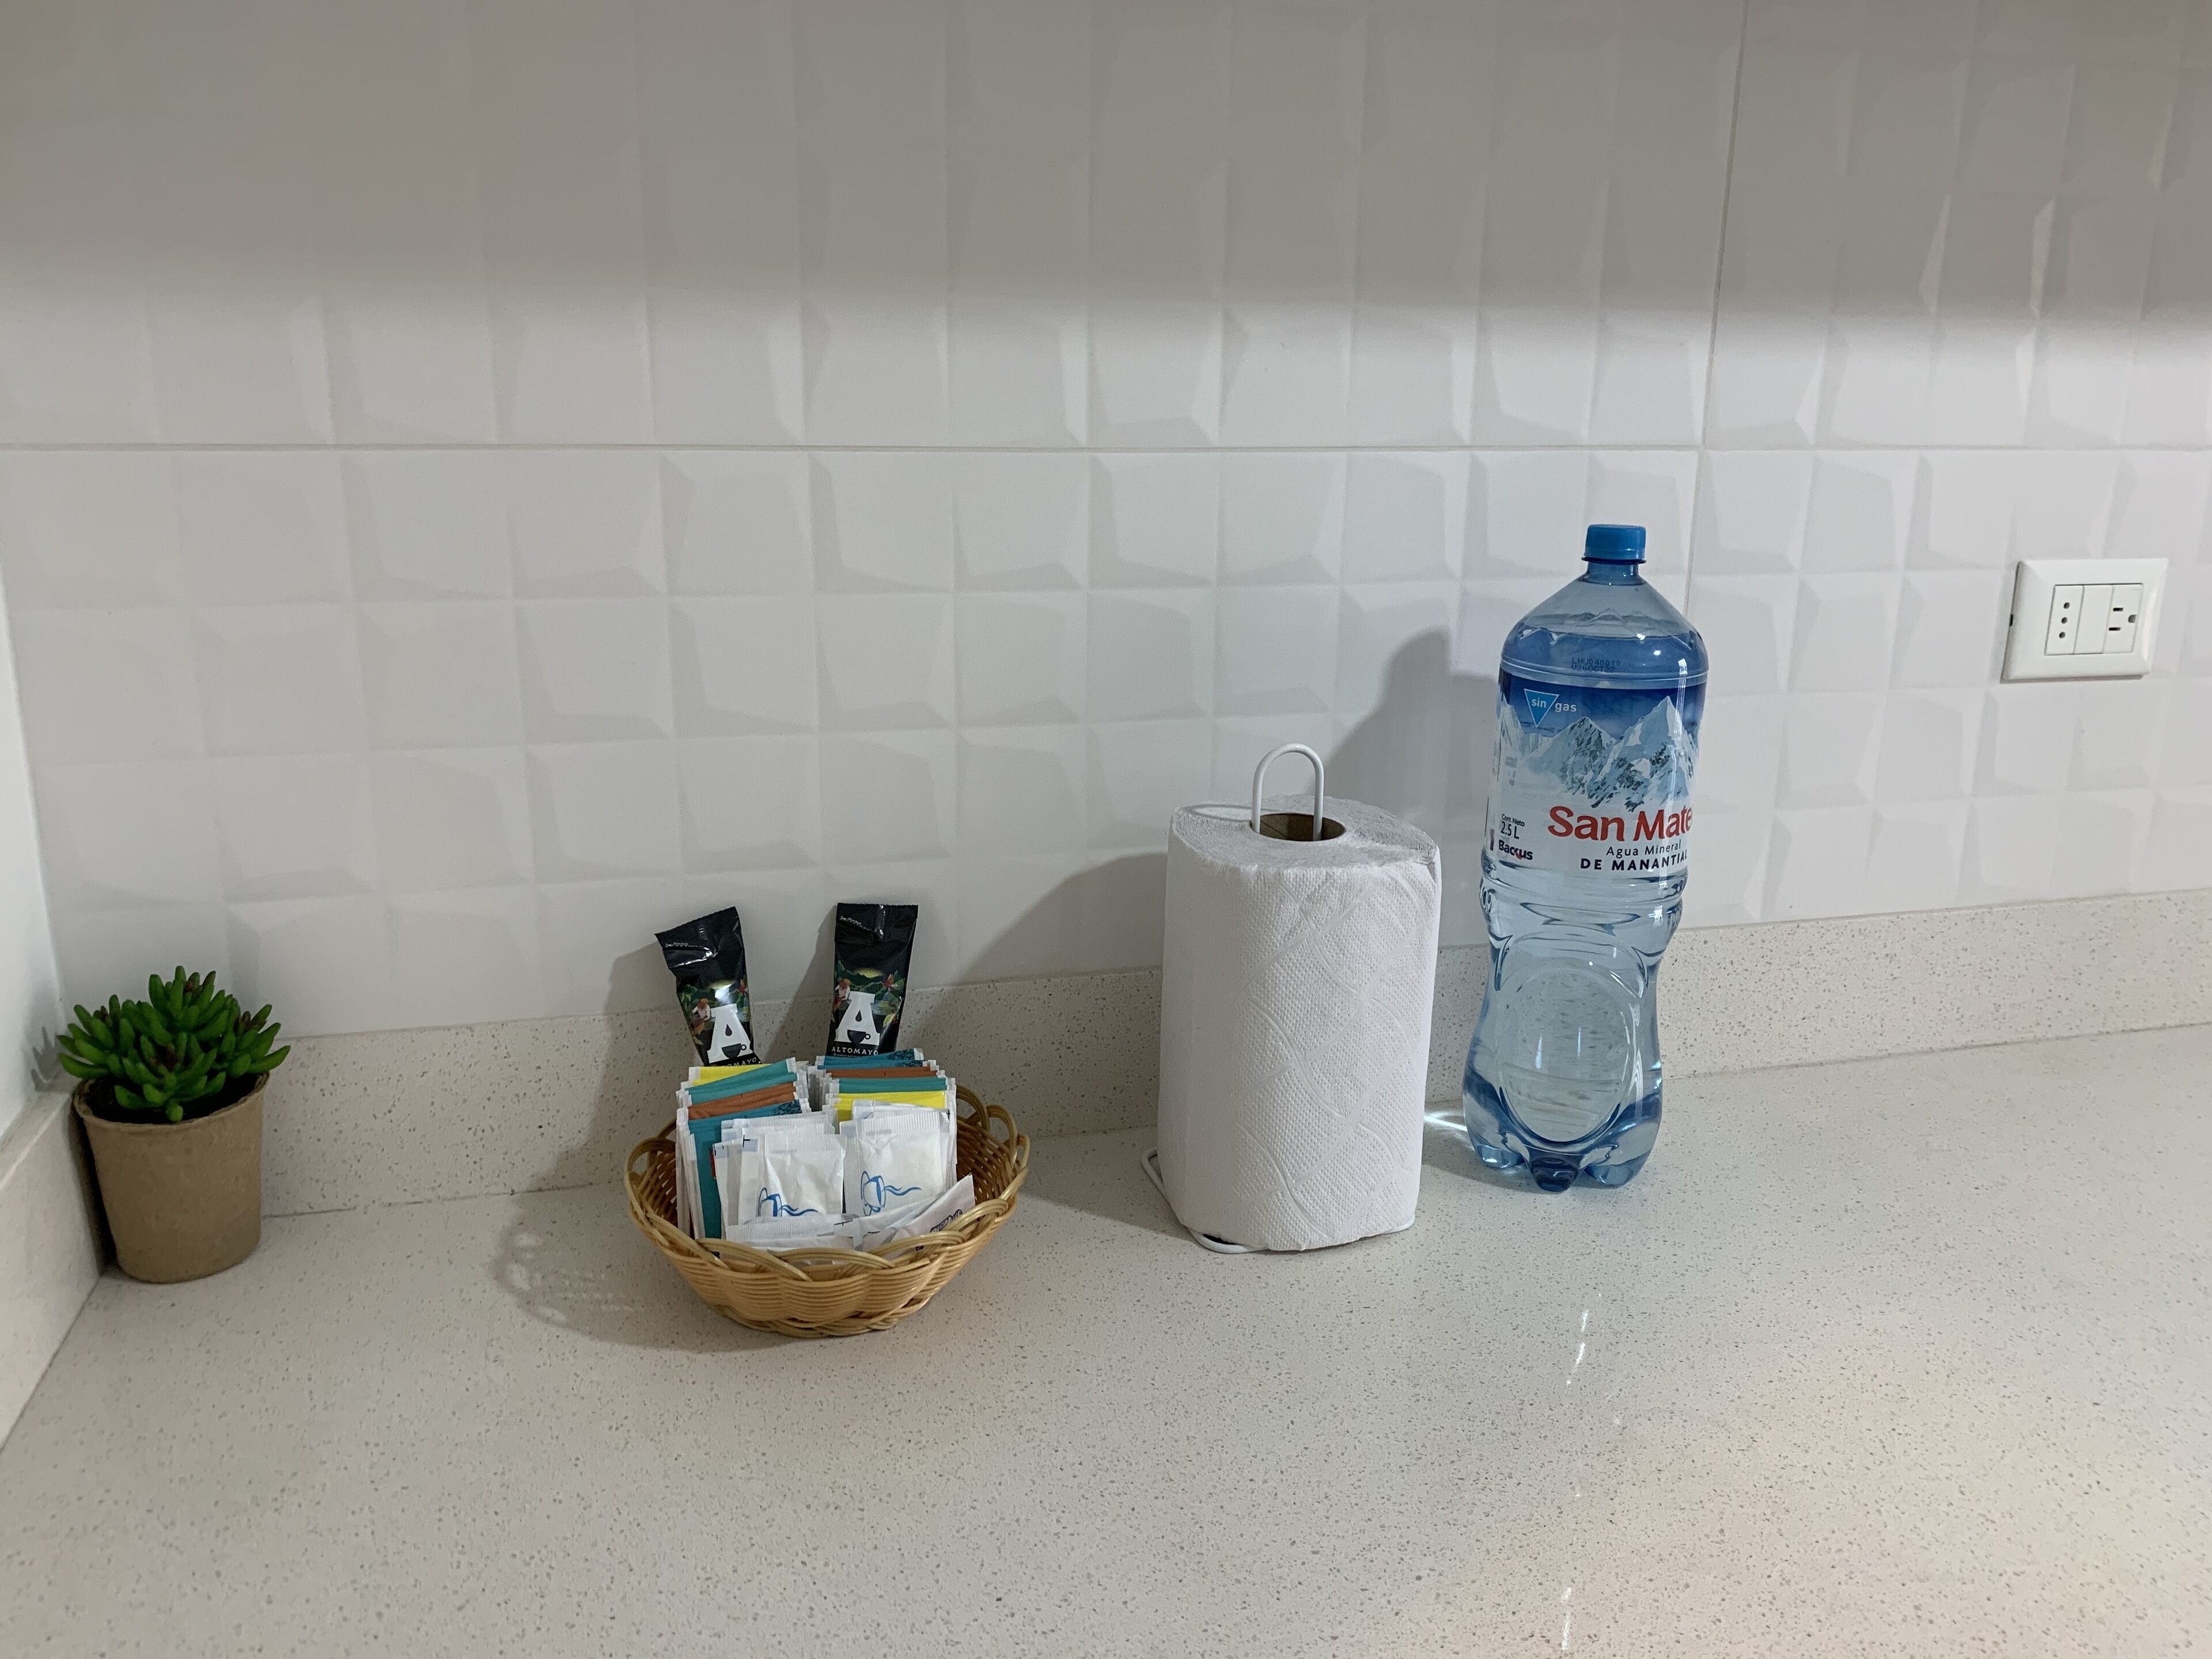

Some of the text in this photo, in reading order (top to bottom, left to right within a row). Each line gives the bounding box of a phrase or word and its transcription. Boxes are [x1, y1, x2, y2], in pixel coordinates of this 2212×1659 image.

[1531, 697, 1577, 713] sin gas
[1500, 820, 1520, 839] 2.5 L
[1512, 817, 1525, 827] Neto
[1547, 805, 1693, 842] San Mate
[1498, 839, 1533, 861] Backus
[1605, 839, 1681, 859] Agua Mineral
[1580, 849, 1688, 871] DE MANANTIAL
[831, 1046, 878, 1056] ALTOMAYO
